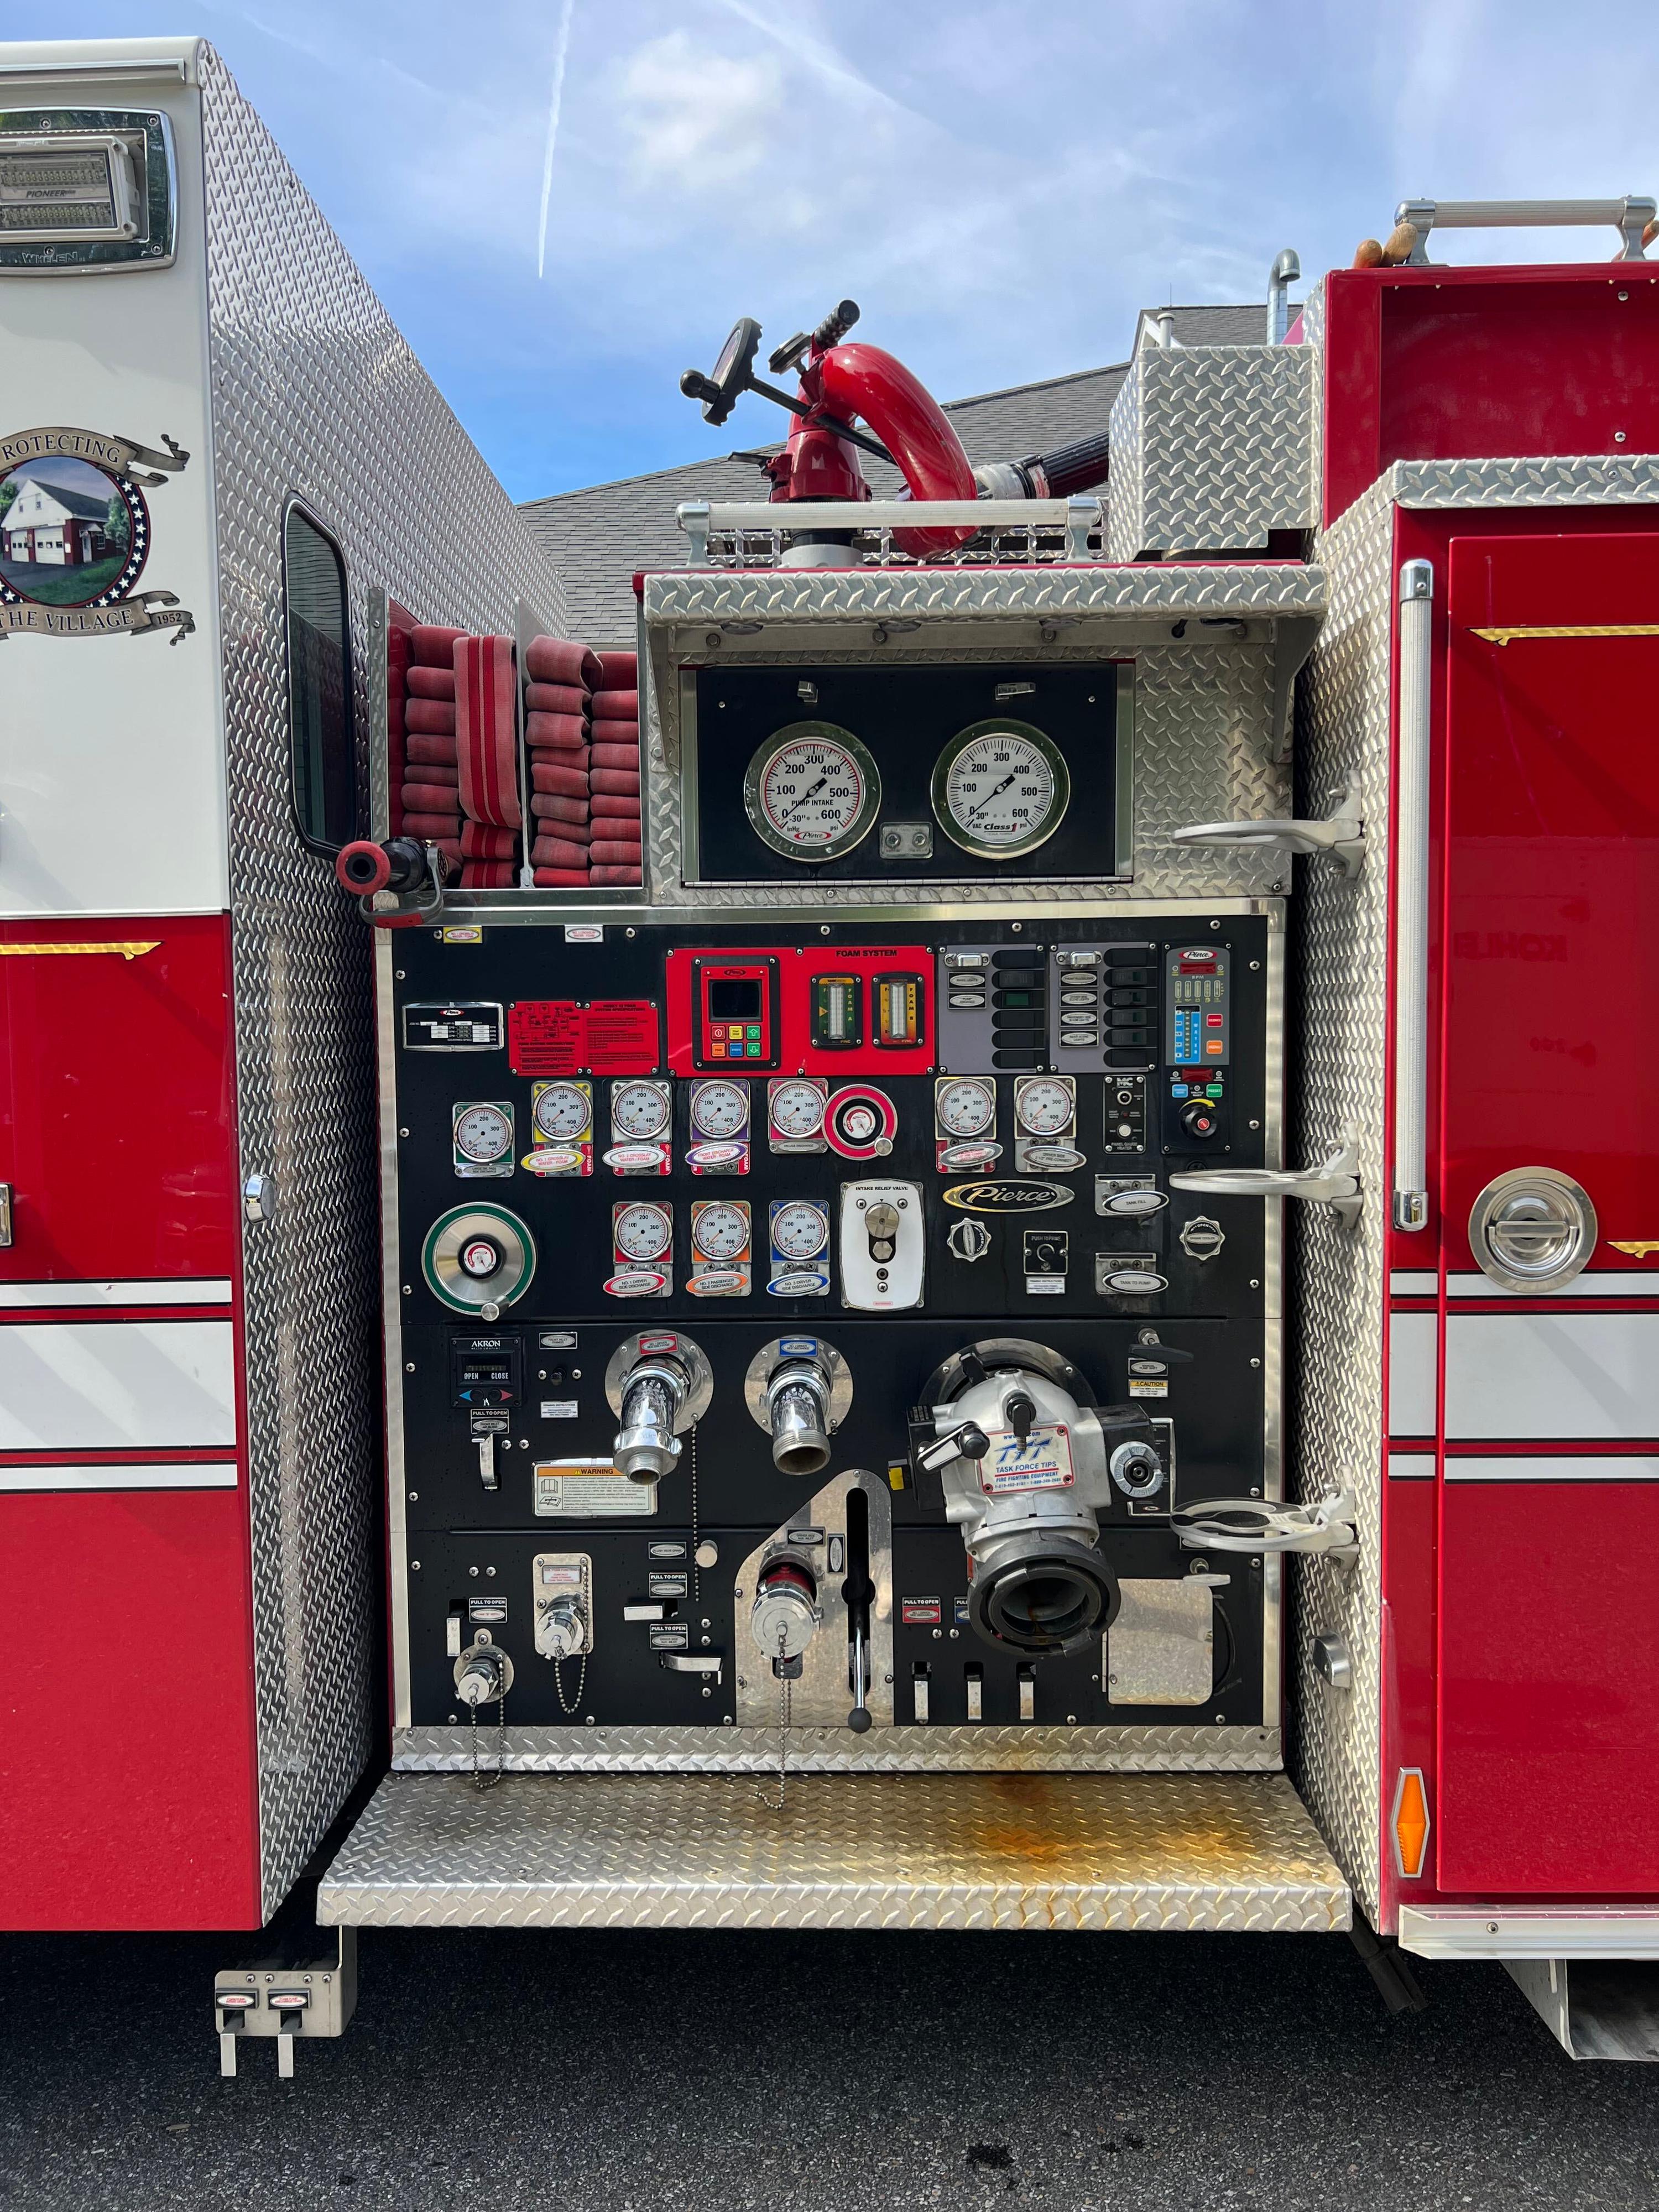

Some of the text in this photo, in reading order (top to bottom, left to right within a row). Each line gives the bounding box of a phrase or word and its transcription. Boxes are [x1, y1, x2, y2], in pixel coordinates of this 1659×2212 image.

[26, 190, 65, 198] PIONEER
[22, 252, 78, 263] WHELEN
[45, 609, 134, 632] VILLAGE
[157, 612, 182, 624] 1952
[805, 755, 824, 764] 300
[993, 753, 1010, 762] 300
[785, 764, 805, 774] 200
[821, 765, 841, 775] 400
[971, 763, 988, 773] 200
[1013, 765, 1030, 774] 400
[776, 785, 796, 795] 100
[829, 787, 849, 797] 500
[962, 783, 977, 792] 100
[1021, 787, 1037, 796] 500
[781, 809, 788, 818] 0
[821, 810, 841, 820] 600
[969, 806, 975, 815] 0
[1012, 808, 1029, 817] 600
[802, 831, 823, 839] Pierce
[966, 1187, 1053, 1203] Pierce
